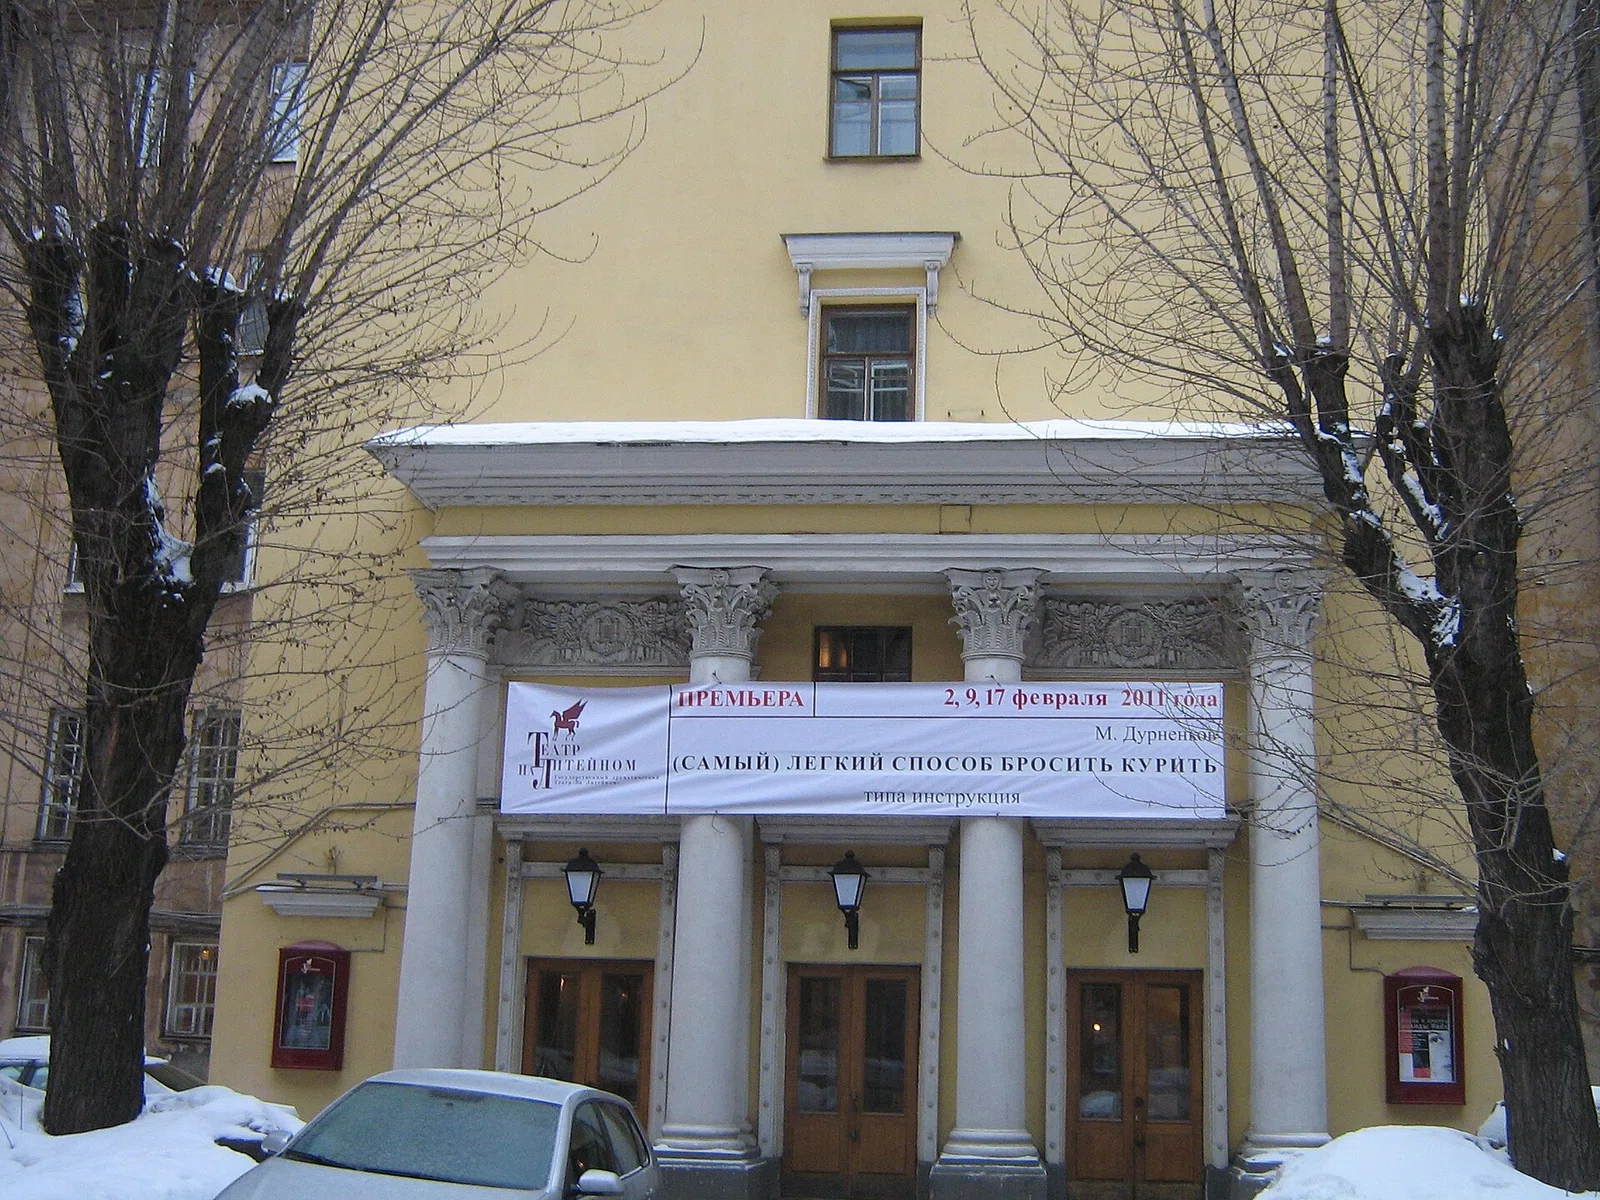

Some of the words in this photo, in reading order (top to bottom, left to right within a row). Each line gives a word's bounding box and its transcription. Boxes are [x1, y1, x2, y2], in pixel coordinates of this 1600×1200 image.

[678, 690, 804, 707] ПРЕМЬЕРА
[943, 689, 960, 709] 2,
[965, 688, 980, 709] 9,
[986, 689, 1005, 706] 17
[1012, 689, 1108, 710] февраля
[1121, 689, 1165, 707] 2011
[1172, 693, 1218, 708] года
[1095, 726, 1117, 742] М.
[1122, 726, 1218, 745] Дурненков
[673, 751, 780, 773] (САМЫЙ)
[786, 752, 884, 771] ЛЕГКИЙ
[892, 756, 993, 772] СПОСОБ
[1001, 757, 1113, 773] БРОСИТЬ
[1121, 757, 1217, 774] КУРИТЬ
[864, 791, 906, 803] типа
[912, 792, 1021, 807] инструкция
